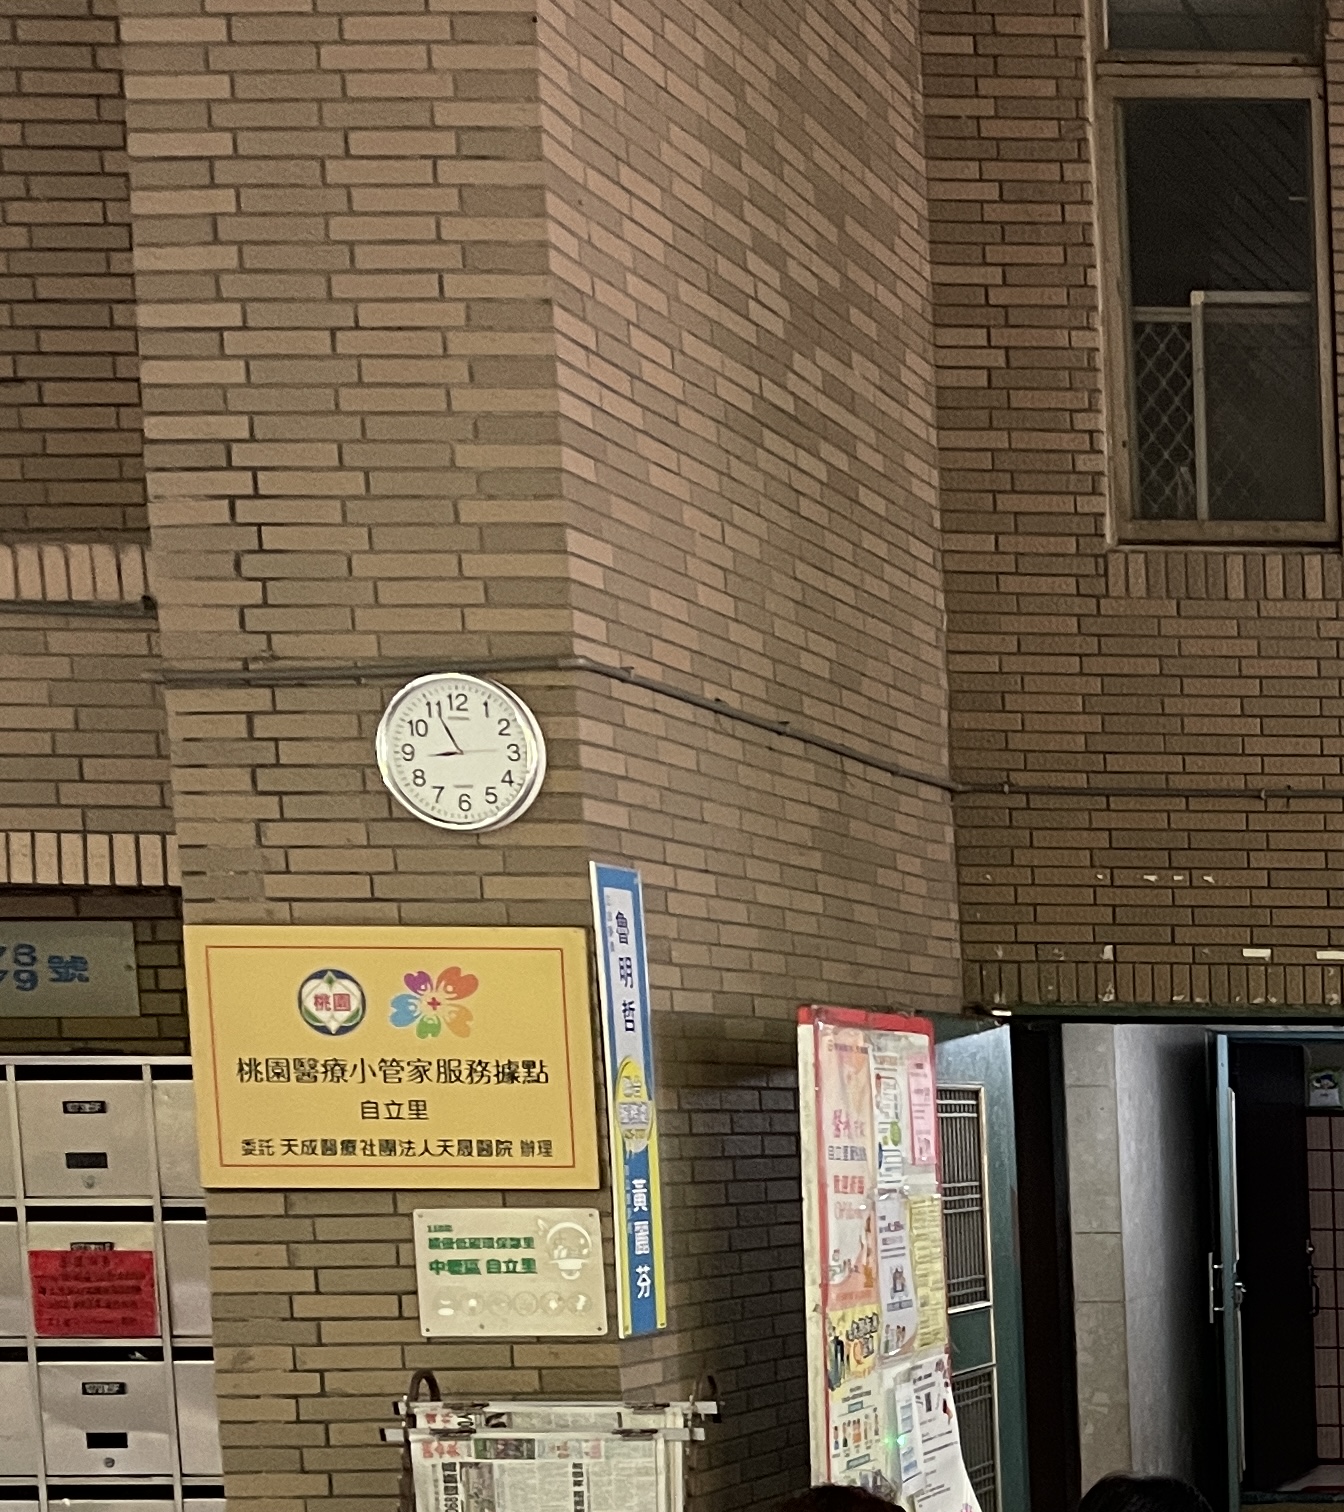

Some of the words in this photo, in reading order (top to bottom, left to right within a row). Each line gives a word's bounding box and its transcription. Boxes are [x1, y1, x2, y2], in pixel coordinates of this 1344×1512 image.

[426, 701, 442, 718] 11
[448, 693, 468, 711] 12
[483, 701, 489, 718] 1
[407, 719, 428, 737] 10
[498, 718, 511, 736] 2
[401, 743, 415, 761] 9
[507, 744, 520, 761] 3
[413, 769, 426, 787] 8
[501, 770, 514, 787] 4
[432, 786, 445, 803] 7
[458, 794, 471, 812] 6
[485, 787, 498, 804] 5
[615, 911, 636, 1032] 魯明哲
[313, 993, 351, 1012] 桃園
[236, 1057, 550, 1086] 桃園醫療小管家服務據點
[360, 1099, 430, 1121] 自立里
[241, 1138, 275, 1157] 委託
[281, 1138, 513, 1158] 天成醫療社團法人天晟醫院
[520, 1139, 553, 1158] 辦理
